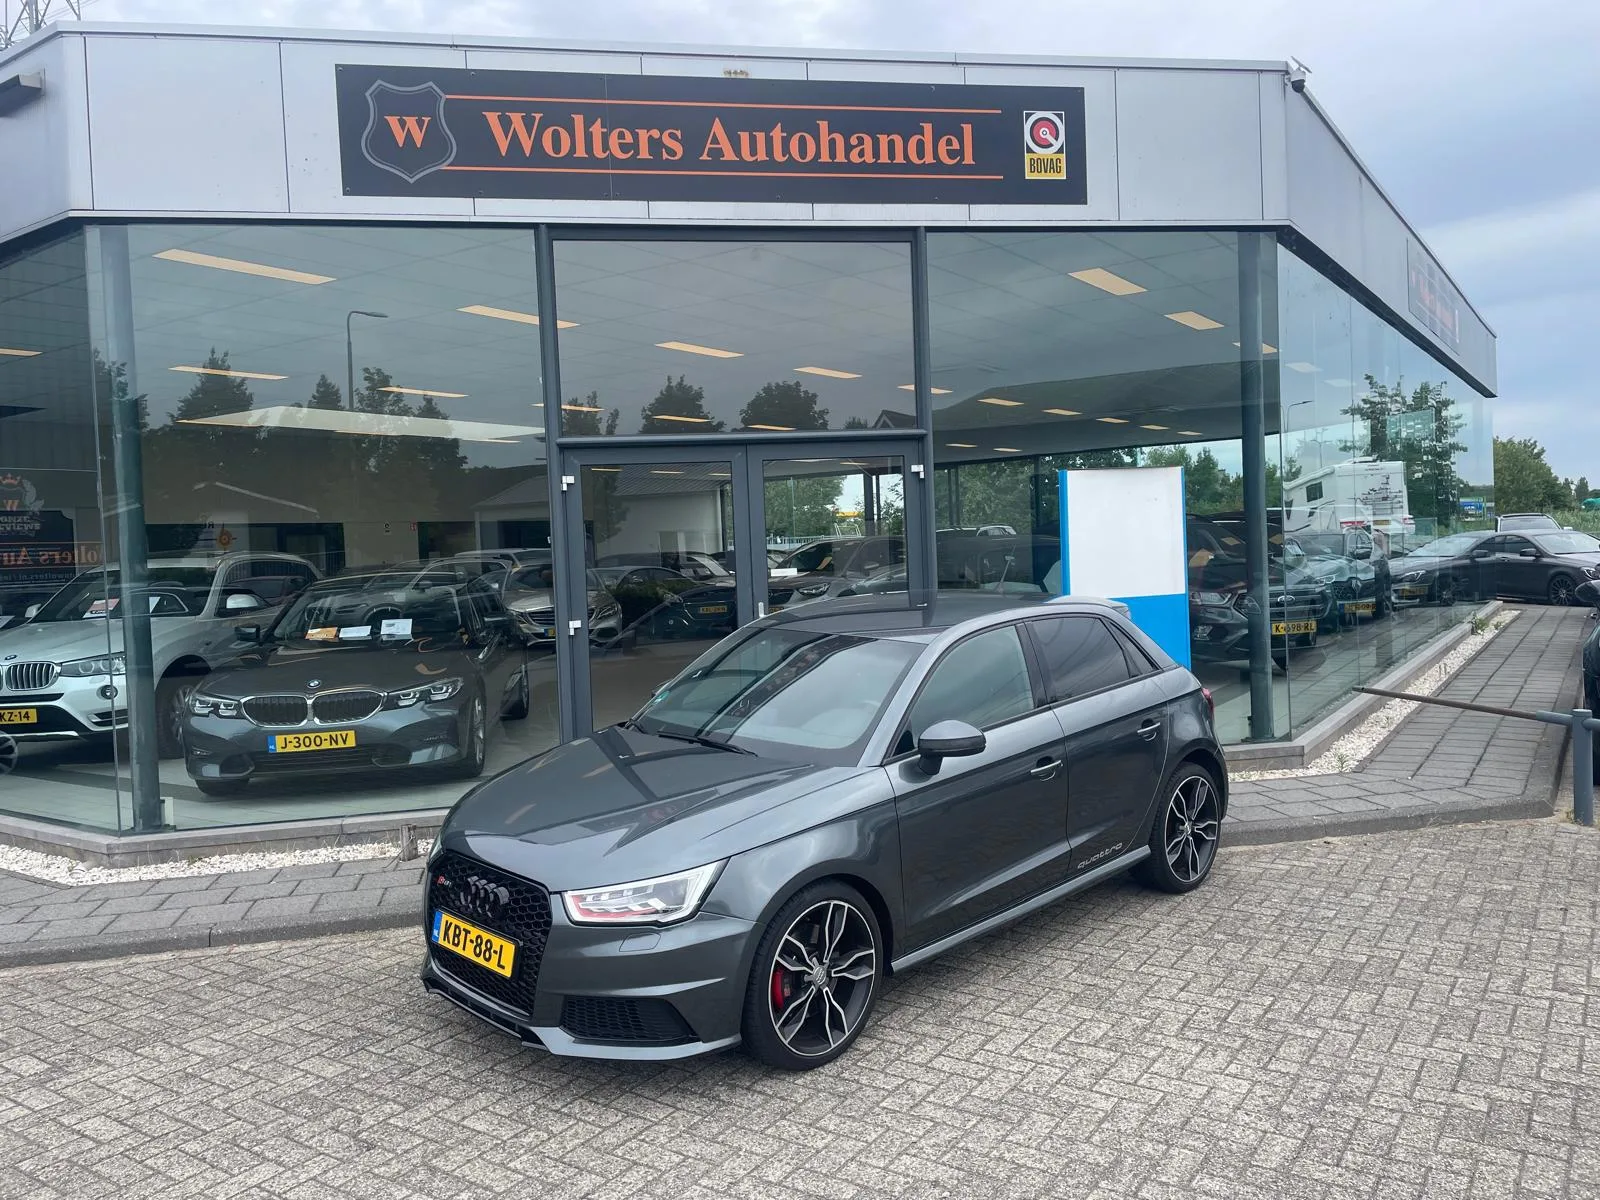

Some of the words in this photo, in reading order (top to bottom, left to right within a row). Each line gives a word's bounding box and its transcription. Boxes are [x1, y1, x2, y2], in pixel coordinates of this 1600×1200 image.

[383, 115, 431, 148] W
[482, 111, 684, 161] Wolters
[699, 116, 976, 165] Autohandel
[1029, 157, 1062, 174] BOVAG
[281, 733, 349, 749] J-300-NV
[1077, 842, 1122, 869] quattro
[443, 919, 506, 970] KBT-88-L
